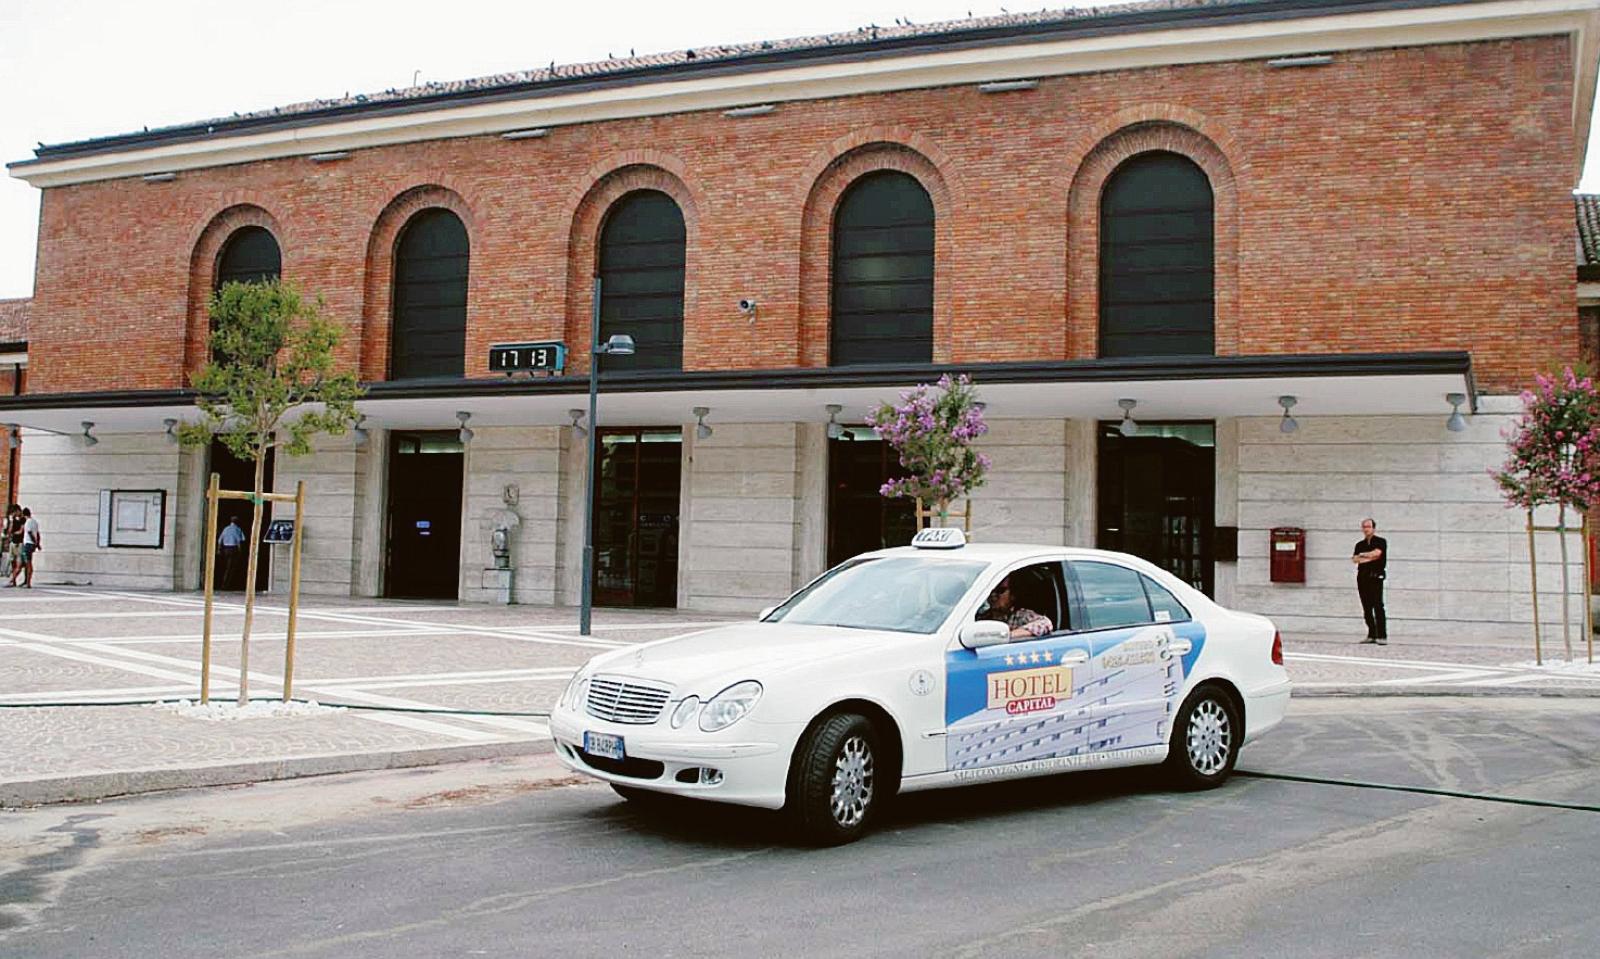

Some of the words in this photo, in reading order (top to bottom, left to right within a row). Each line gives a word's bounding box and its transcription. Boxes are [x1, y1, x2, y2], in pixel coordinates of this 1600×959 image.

[502, 350, 519, 366] 17
[531, 349, 548, 366] 13
[916, 529, 954, 541] TAXI
[992, 673, 1068, 699] HOTEL
[1008, 697, 1055, 713] CAPITAL
